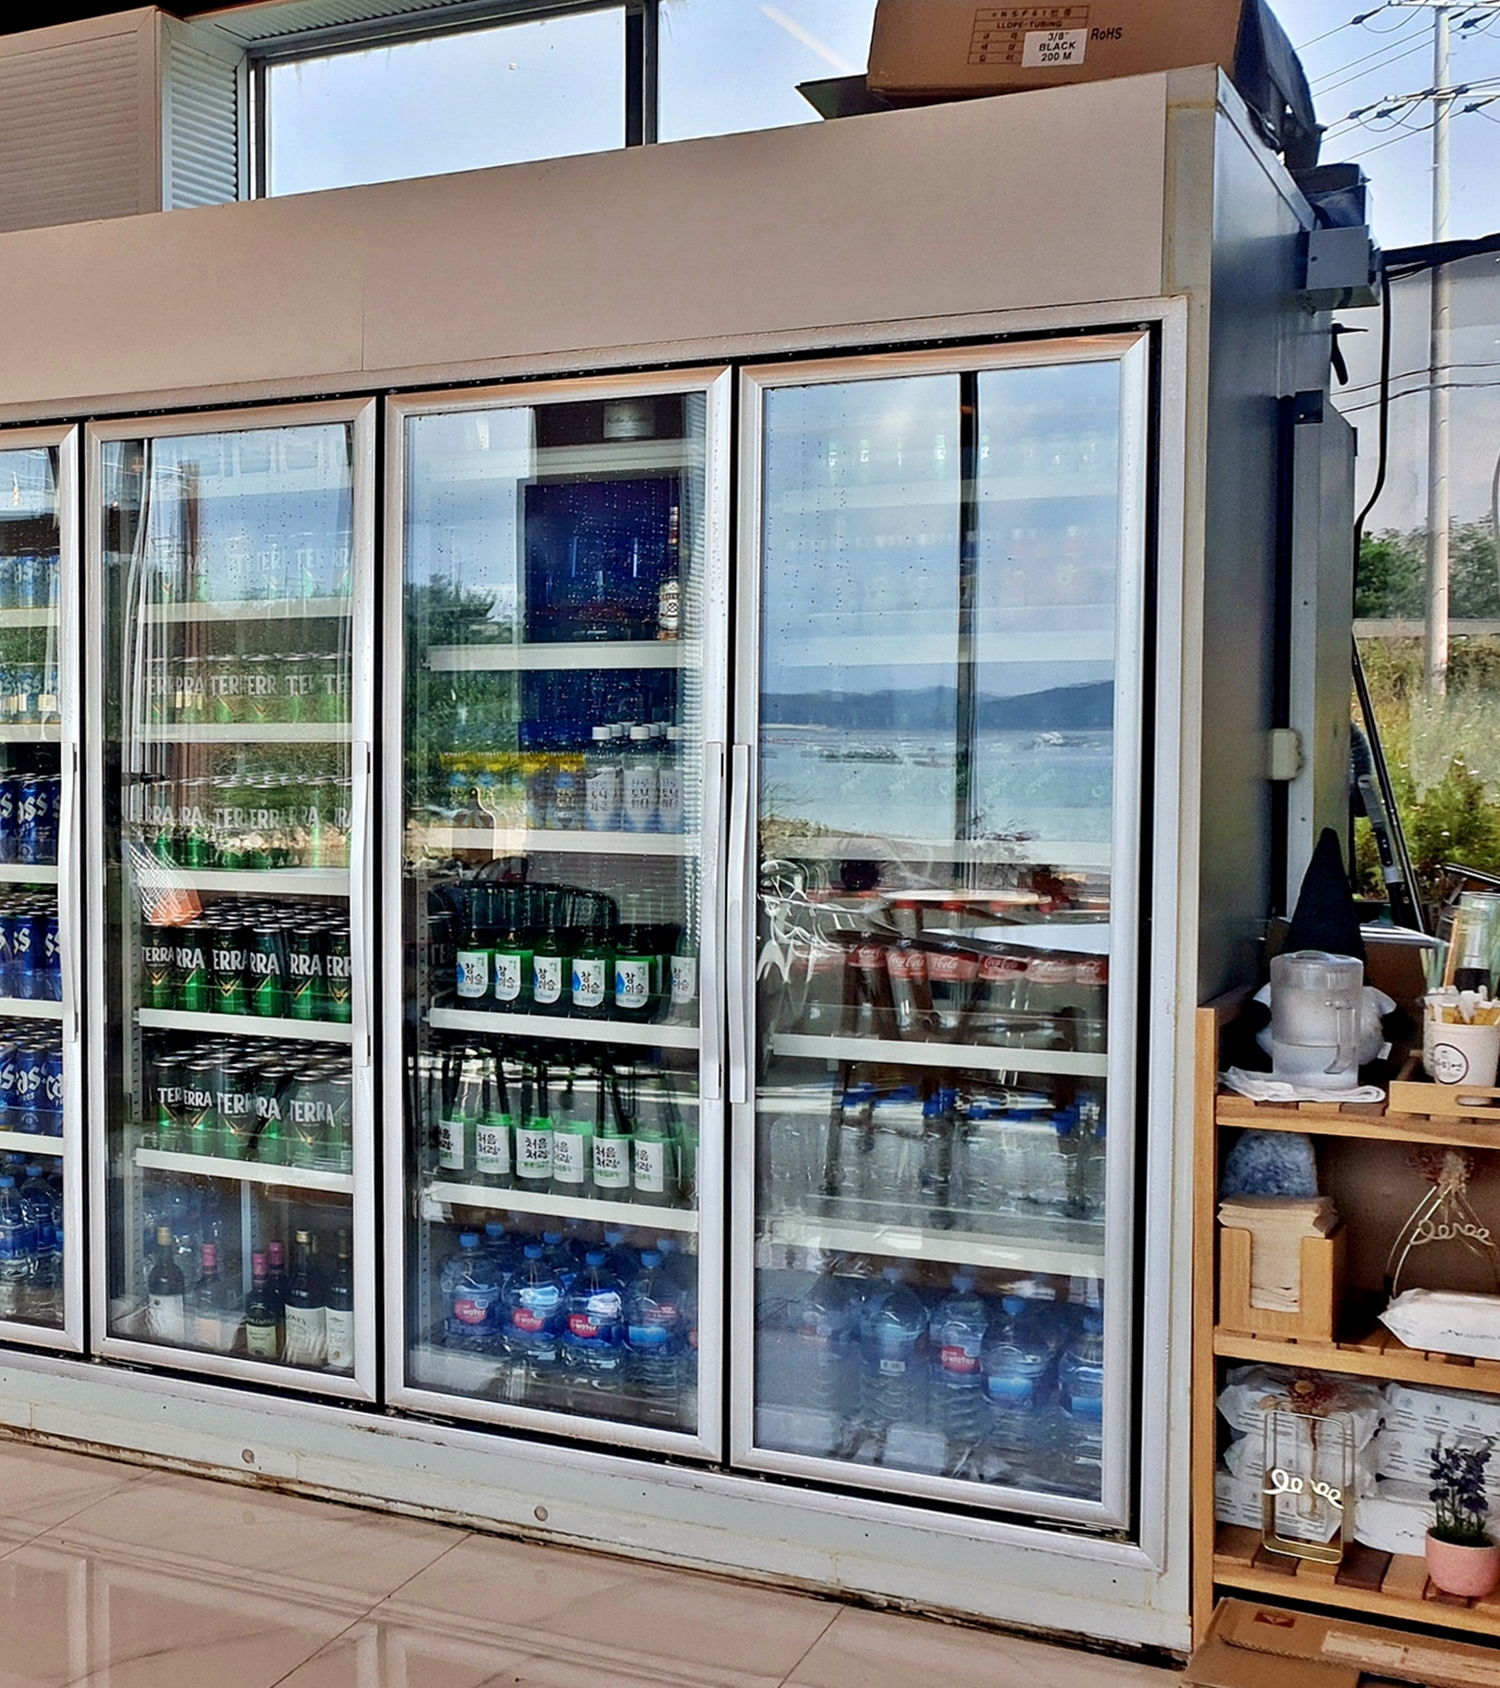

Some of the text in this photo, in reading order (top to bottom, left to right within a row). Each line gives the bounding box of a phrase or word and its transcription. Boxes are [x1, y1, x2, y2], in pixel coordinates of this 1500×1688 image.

[1090, 27, 1122, 40] RoHS
[1039, 41, 1076, 52] BLACK
[1041, 51, 1072, 62] 200 M
[290, 1099, 336, 1128] TERRA
